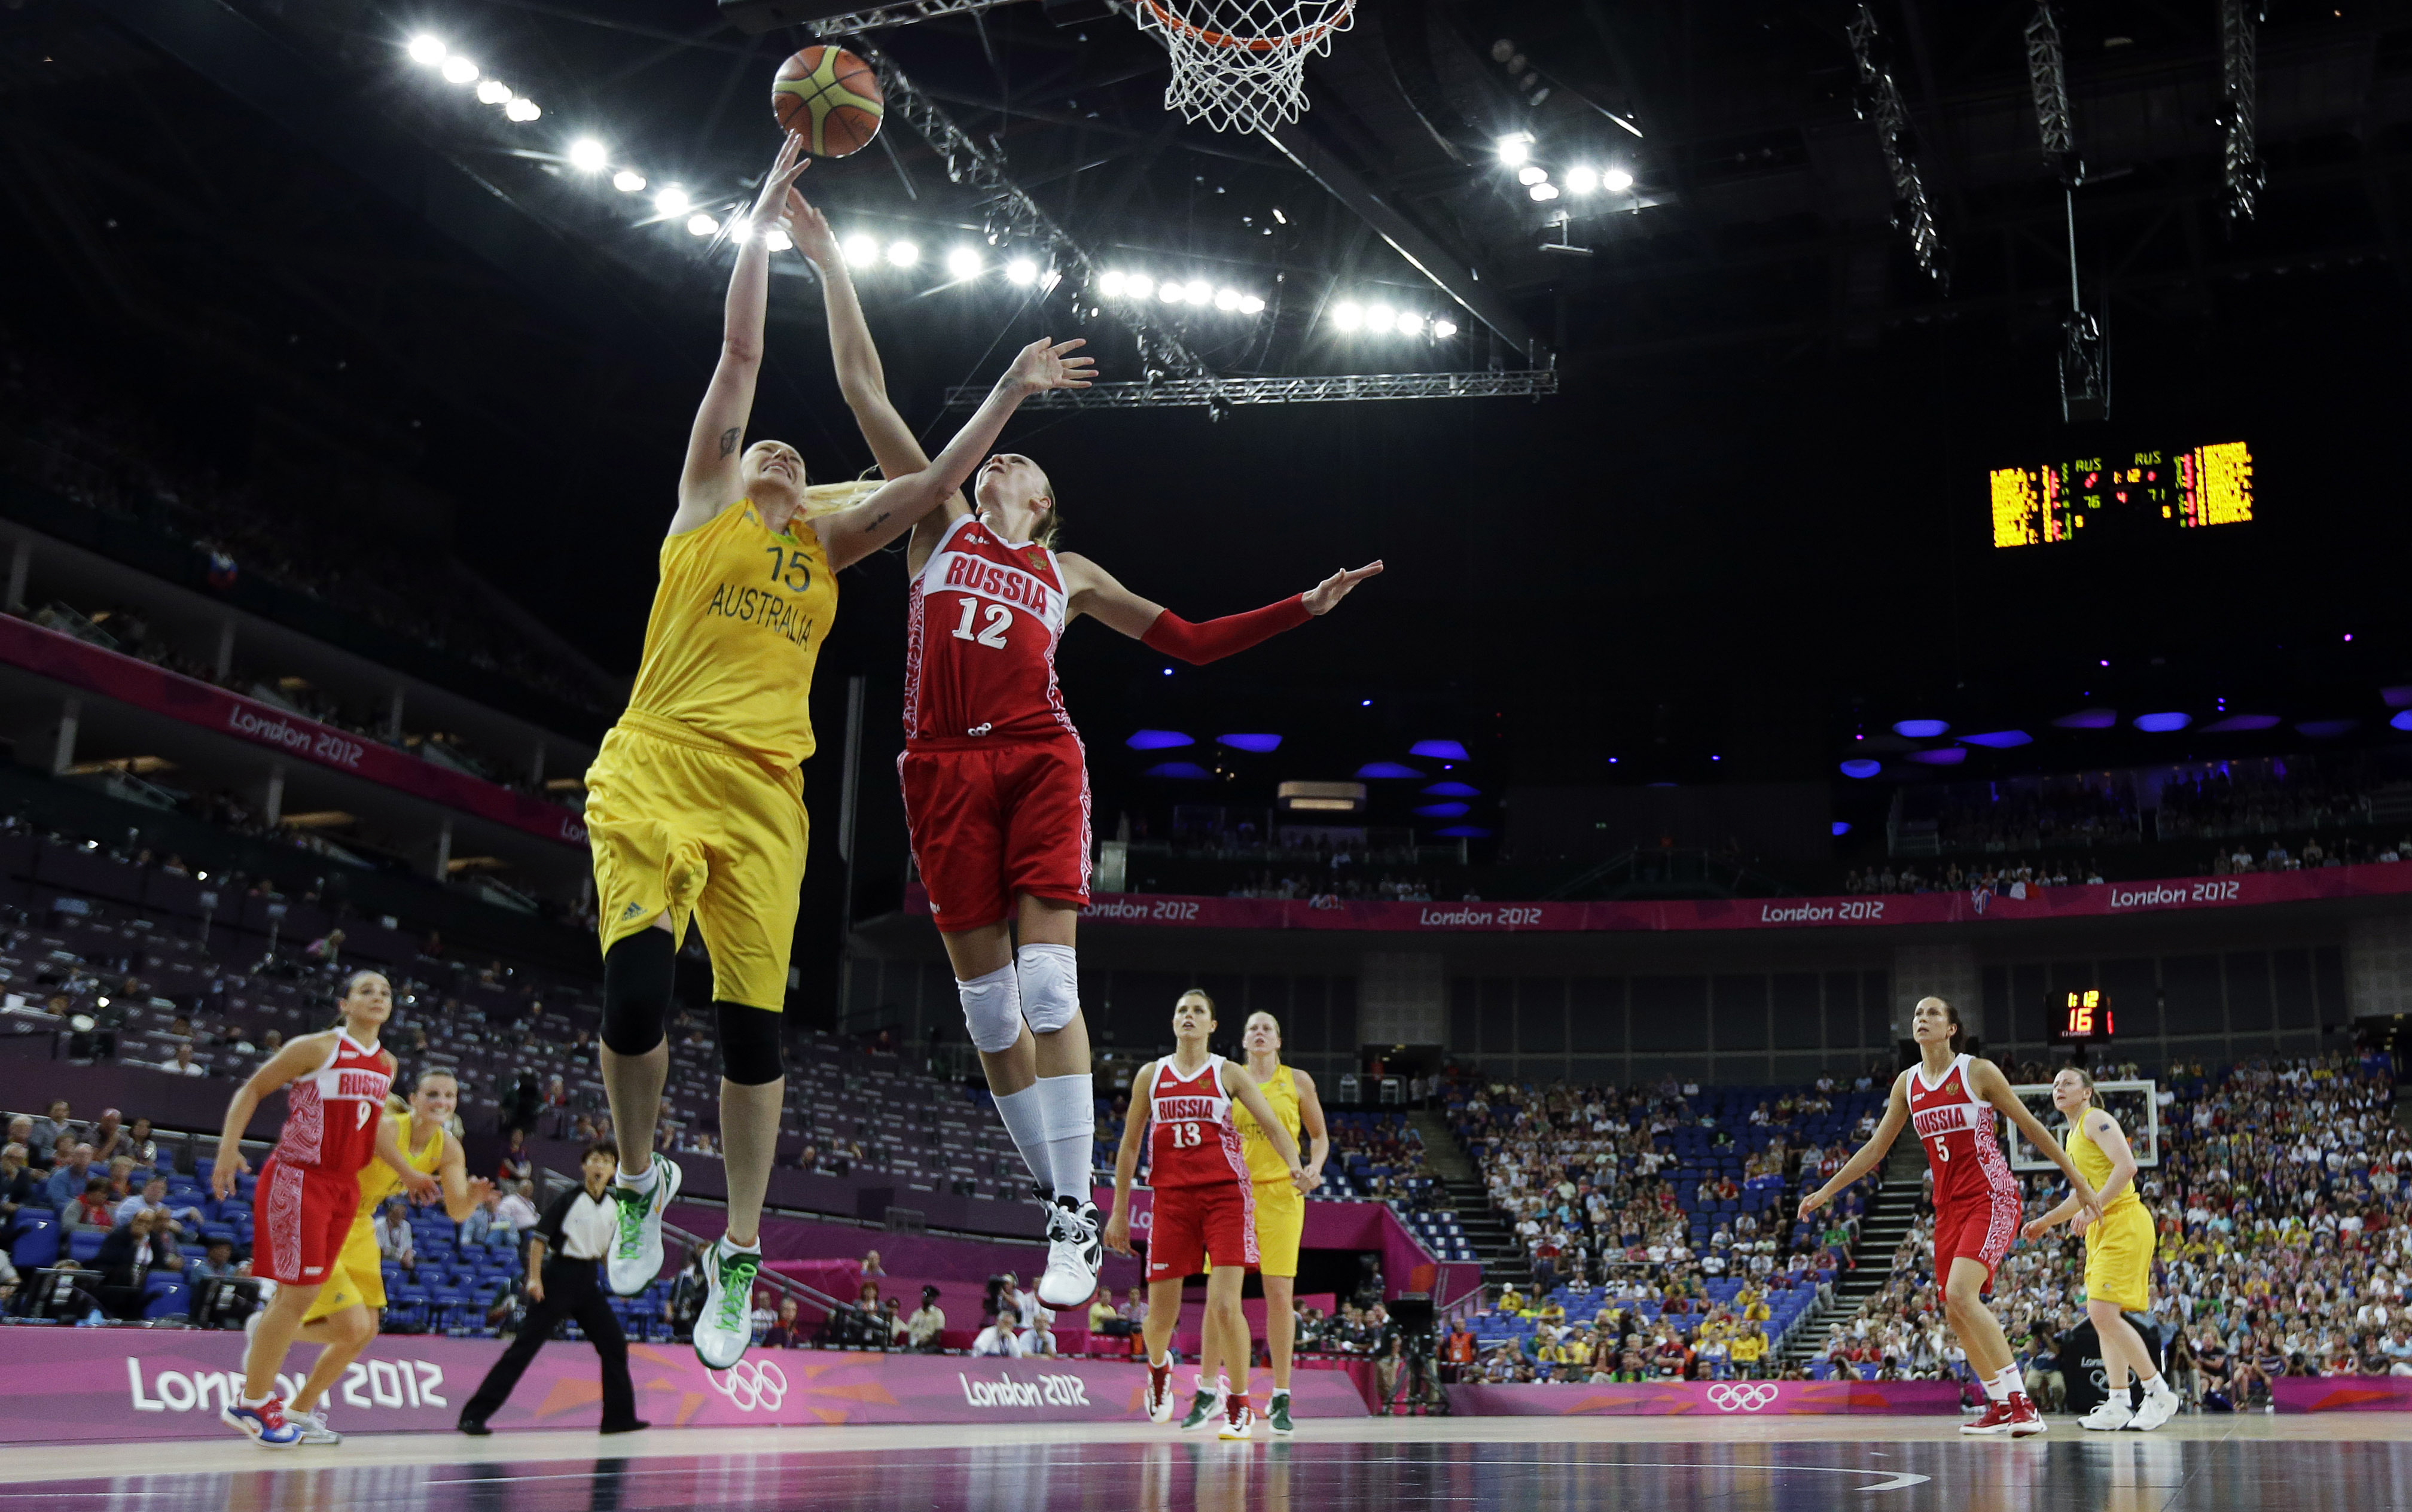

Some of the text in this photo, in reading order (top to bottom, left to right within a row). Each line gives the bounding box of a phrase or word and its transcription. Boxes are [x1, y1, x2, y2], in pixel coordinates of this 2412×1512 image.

[2134, 450, 2161, 465] RUS
[766, 546, 813, 593] 15
[944, 554, 1048, 618] RUSSIA
[707, 583, 813, 652] AUSTRALIA
[952, 597, 1013, 650] 12
[230, 705, 364, 769] London 2012
[560, 817, 588, 844] Lon
[2111, 880, 2240, 907] London 2012
[1152, 901, 1199, 920] 2012
[1420, 906, 1542, 925] London 2012
[1761, 901, 1884, 922] London 2012
[2069, 1007, 2093, 1031] 16
[356, 1101, 371, 1126] 9
[1158, 1099, 1213, 1120] RUSSIA
[1914, 1106, 1967, 1136] RUSSIA
[1171, 1122, 1202, 1148] 13
[1933, 1135, 1950, 1162] 5
[342, 1358, 448, 1410] 2012
[959, 1371, 1091, 1407] London 2012
